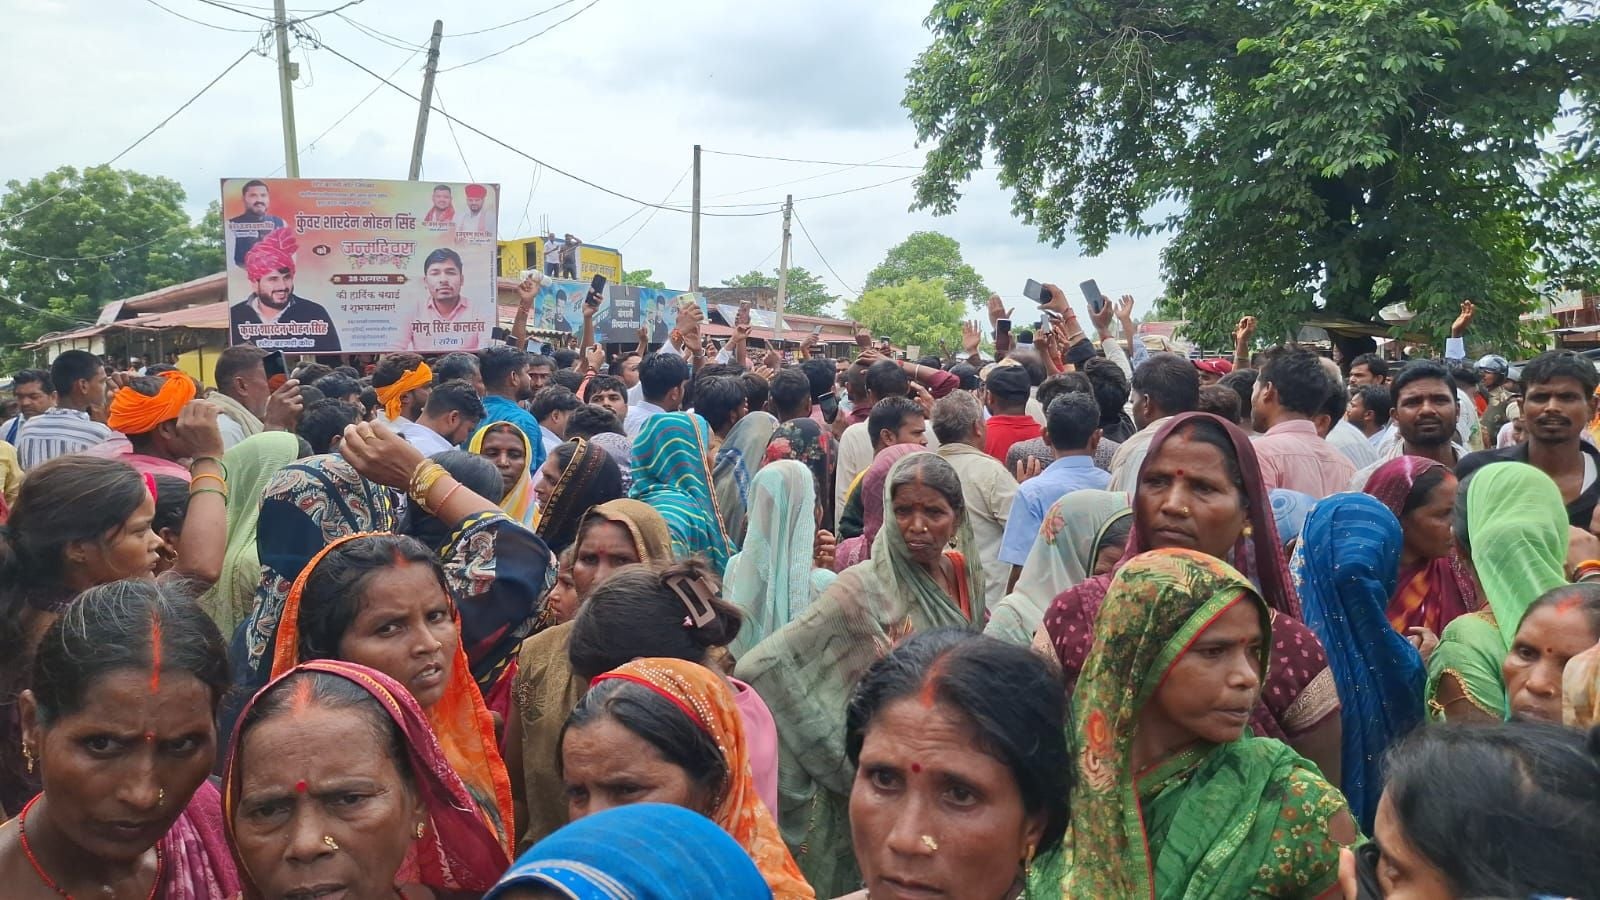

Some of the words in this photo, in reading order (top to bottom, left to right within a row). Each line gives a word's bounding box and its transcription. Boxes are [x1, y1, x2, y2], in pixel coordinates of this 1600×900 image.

[296, 212, 320, 232] कुंवर
[323, 213, 360, 229] शारदेन
[362, 213, 393, 229] मोहन
[396, 212, 416, 230] सिंह
[342, 238, 416, 254] जन्मदिवस
[336, 289, 347, 300] की
[350, 289, 376, 300] हार्दिक
[378, 289, 401, 299] बधाई
[239, 321, 258, 338] कुंवर
[288, 320, 309, 335] मोहन
[311, 320, 328, 335] सिंह
[412, 320, 431, 336] मोनू
[433, 320, 450, 333] सिंह
[453, 319, 485, 332] कलहंस
